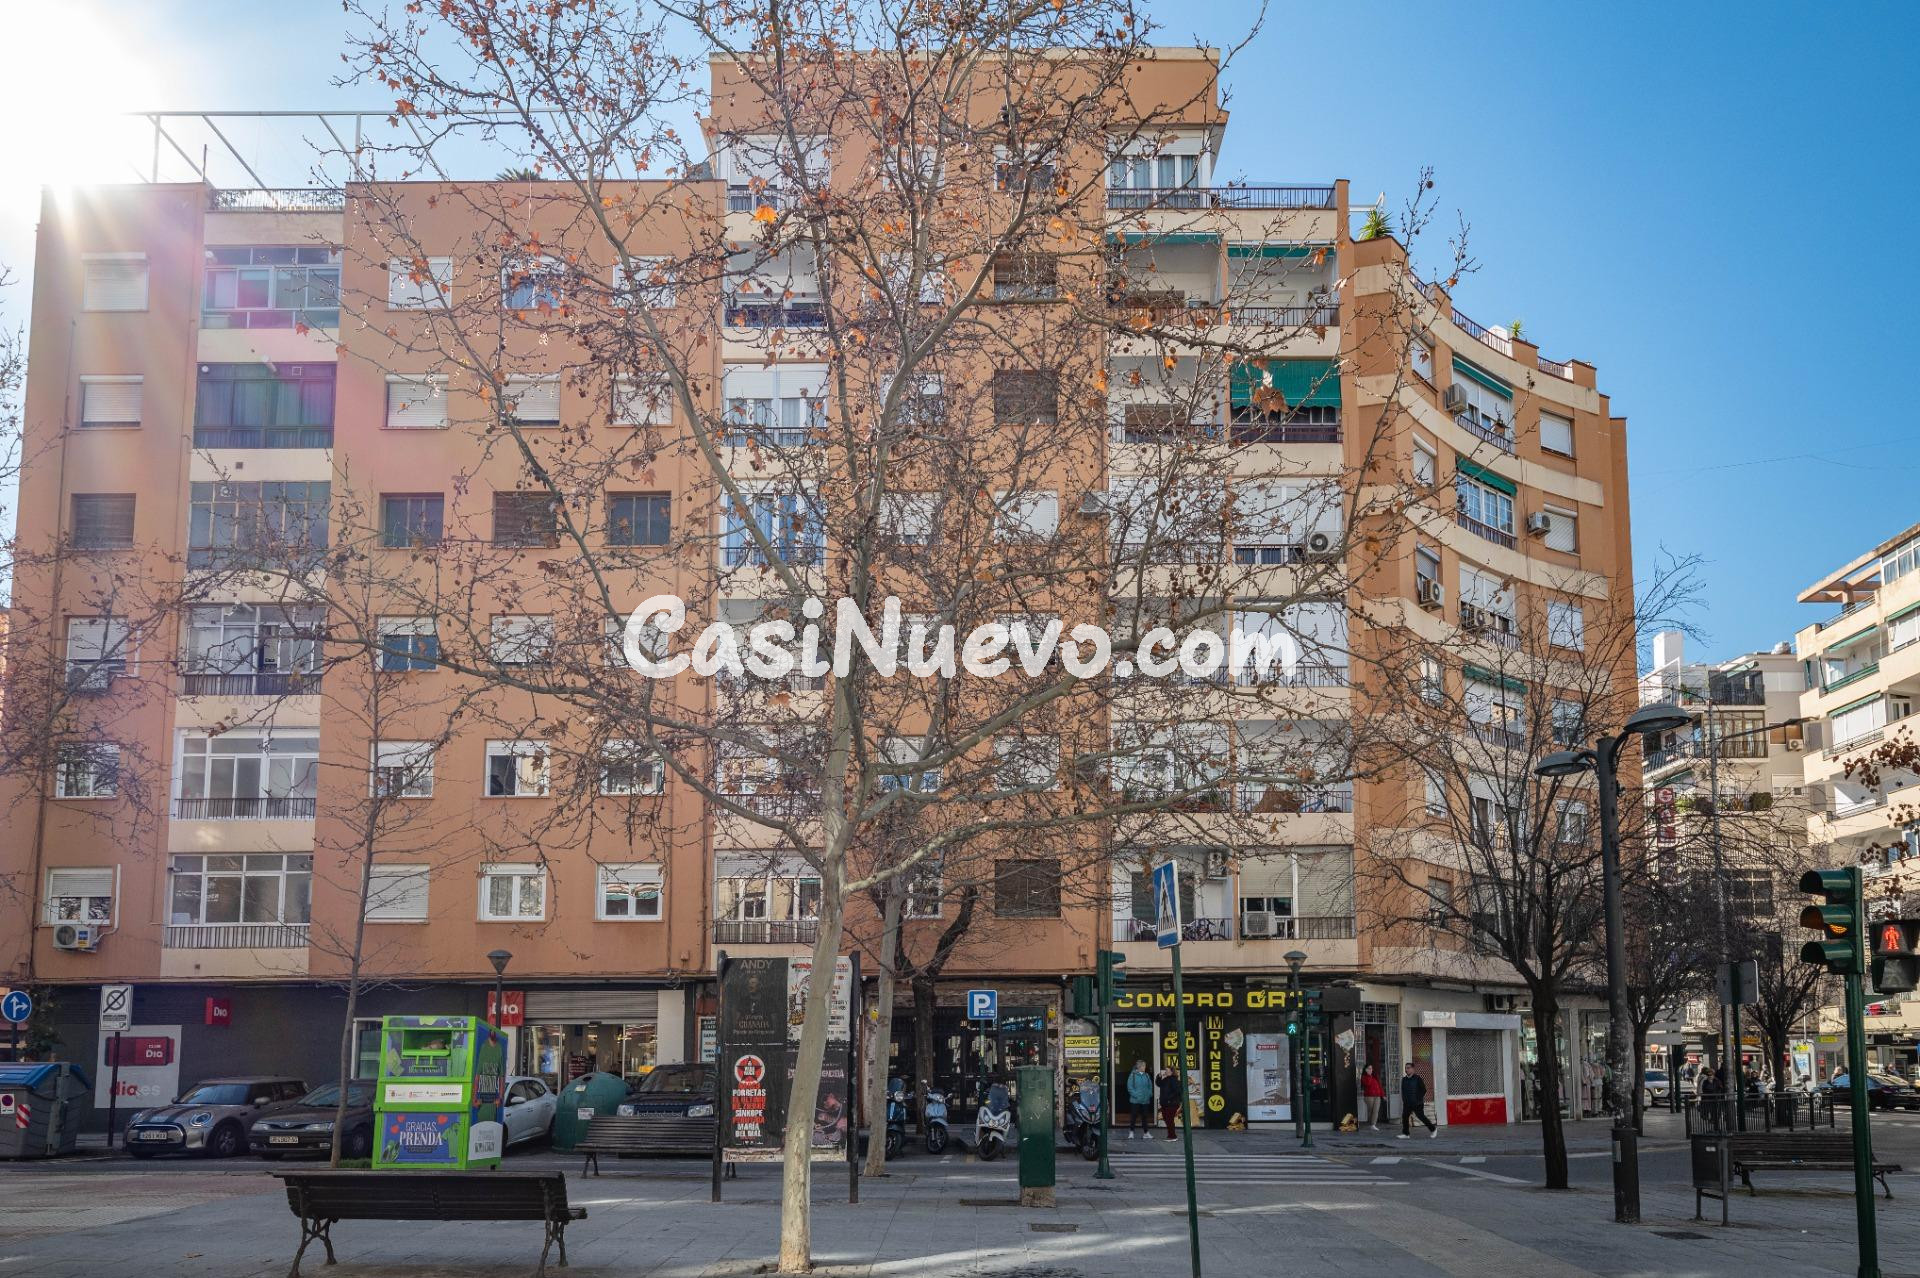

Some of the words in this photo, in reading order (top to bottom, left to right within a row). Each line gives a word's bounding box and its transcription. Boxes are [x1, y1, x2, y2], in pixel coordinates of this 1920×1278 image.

[740, 960, 773, 969] ANDY
[1209, 1031, 1222, 1092] DINERO
[732, 1088, 767, 1097] PORRETAS
[400, 1132, 443, 1146] PRENDA
